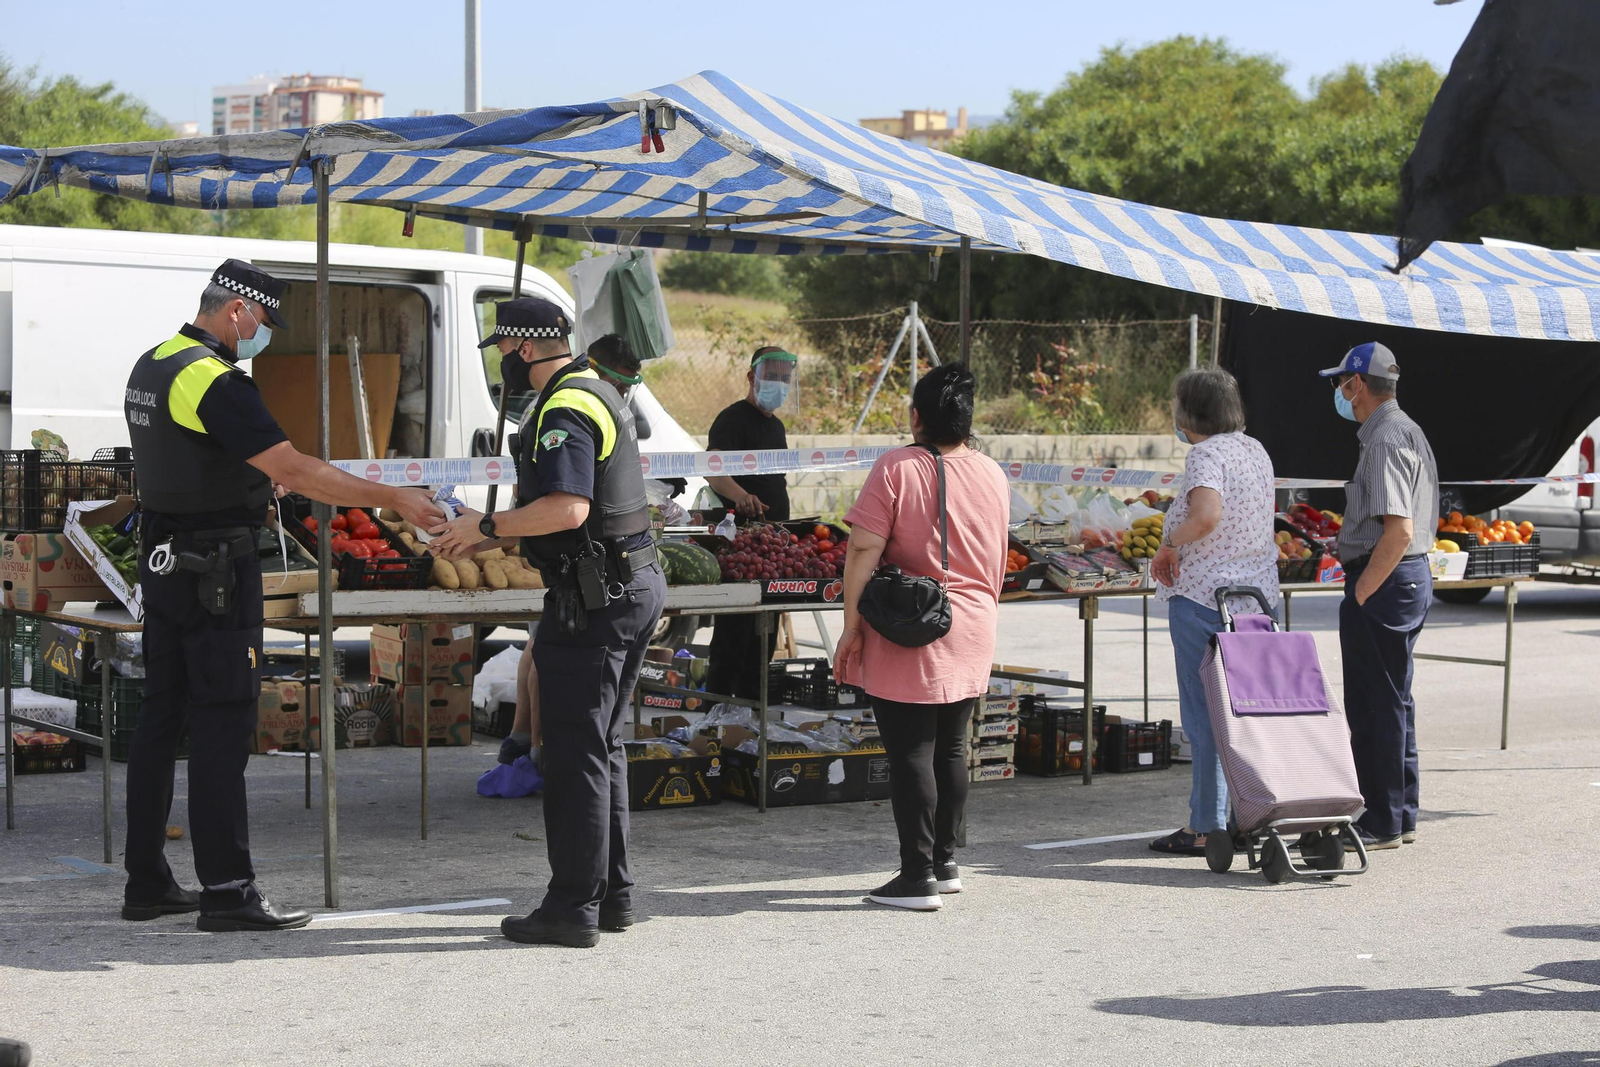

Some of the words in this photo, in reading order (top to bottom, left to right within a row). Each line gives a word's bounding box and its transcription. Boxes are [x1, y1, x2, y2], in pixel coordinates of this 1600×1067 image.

[141, 391, 157, 407] LOCAL
[130, 407, 150, 427] MÁLAGA
[767, 580, 817, 593] DURAN
[644, 695, 682, 708] DURAN
[985, 702, 1007, 711] Josema
[983, 724, 1006, 732] Josema
[980, 768, 1002, 777] Josema
